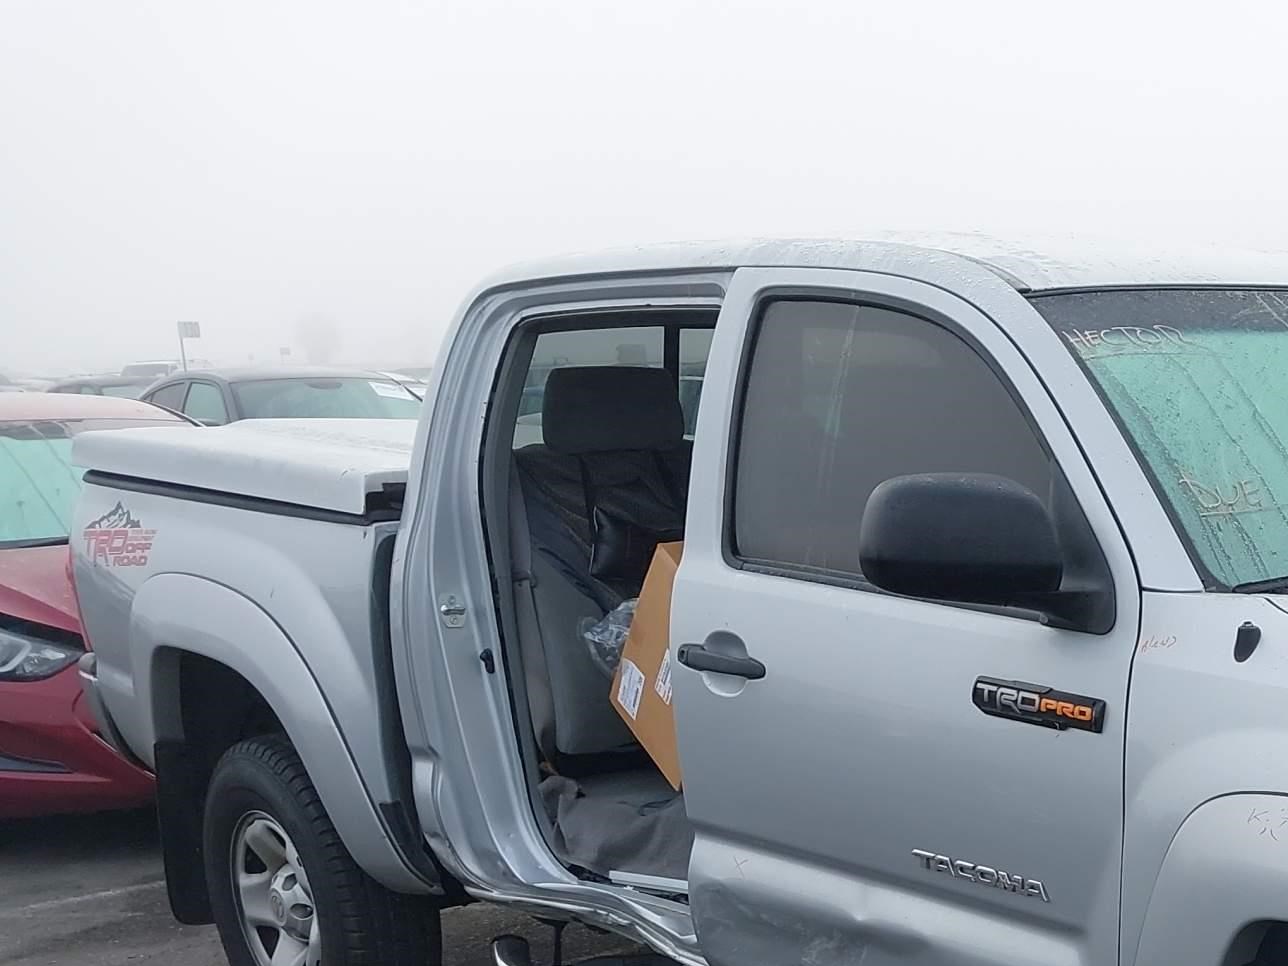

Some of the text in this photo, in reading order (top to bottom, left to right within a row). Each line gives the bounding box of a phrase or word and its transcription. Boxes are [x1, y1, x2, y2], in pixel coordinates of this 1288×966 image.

[1062, 324, 1194, 348] HECTOR
[1179, 471, 1262, 510] DUE
[83, 529, 129, 567] TRD
[112, 556, 148, 567] ROAD
[976, 682, 1093, 720] TRD PRO
[911, 848, 1050, 902] TACOMA
